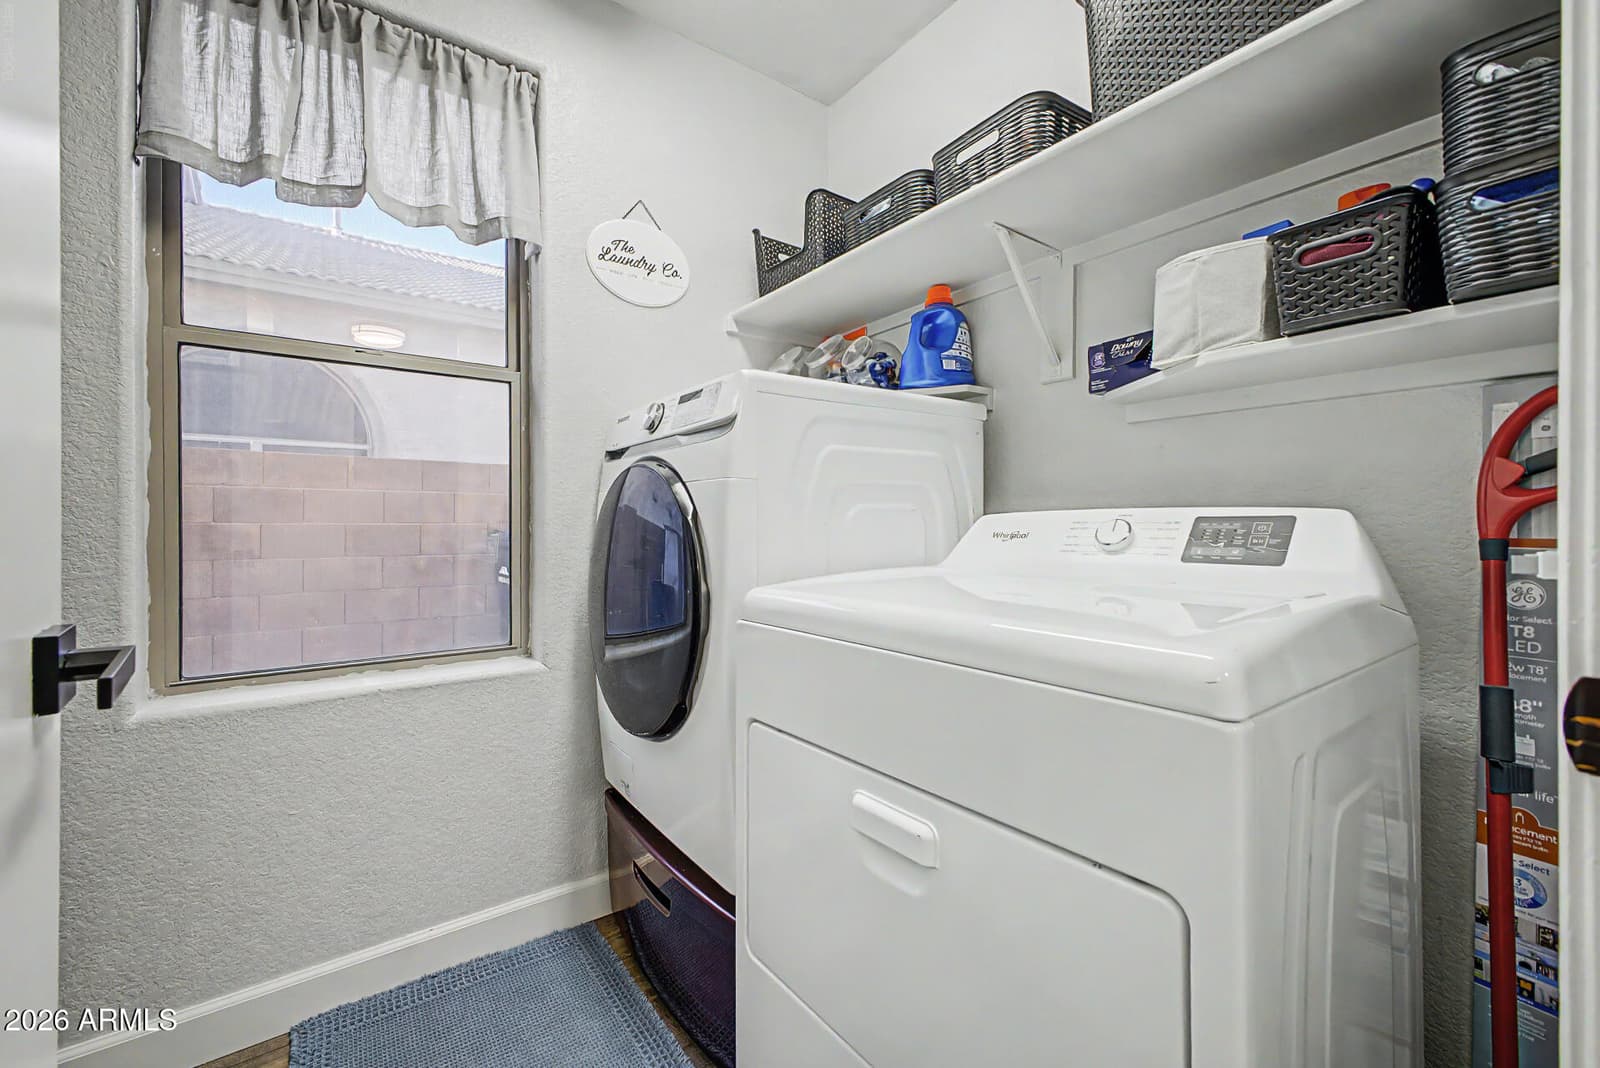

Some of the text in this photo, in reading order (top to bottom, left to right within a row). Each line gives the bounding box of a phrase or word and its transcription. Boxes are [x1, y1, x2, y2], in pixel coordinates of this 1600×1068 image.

[611, 239, 635, 254] The
[597, 246, 657, 277] Laundry
[662, 261, 683, 280] Co.
[1110, 338, 1144, 352] Downy
[992, 530, 1030, 541] Whirlpool
[1509, 624, 1535, 639] T8
[1518, 860, 1551, 876] Select
